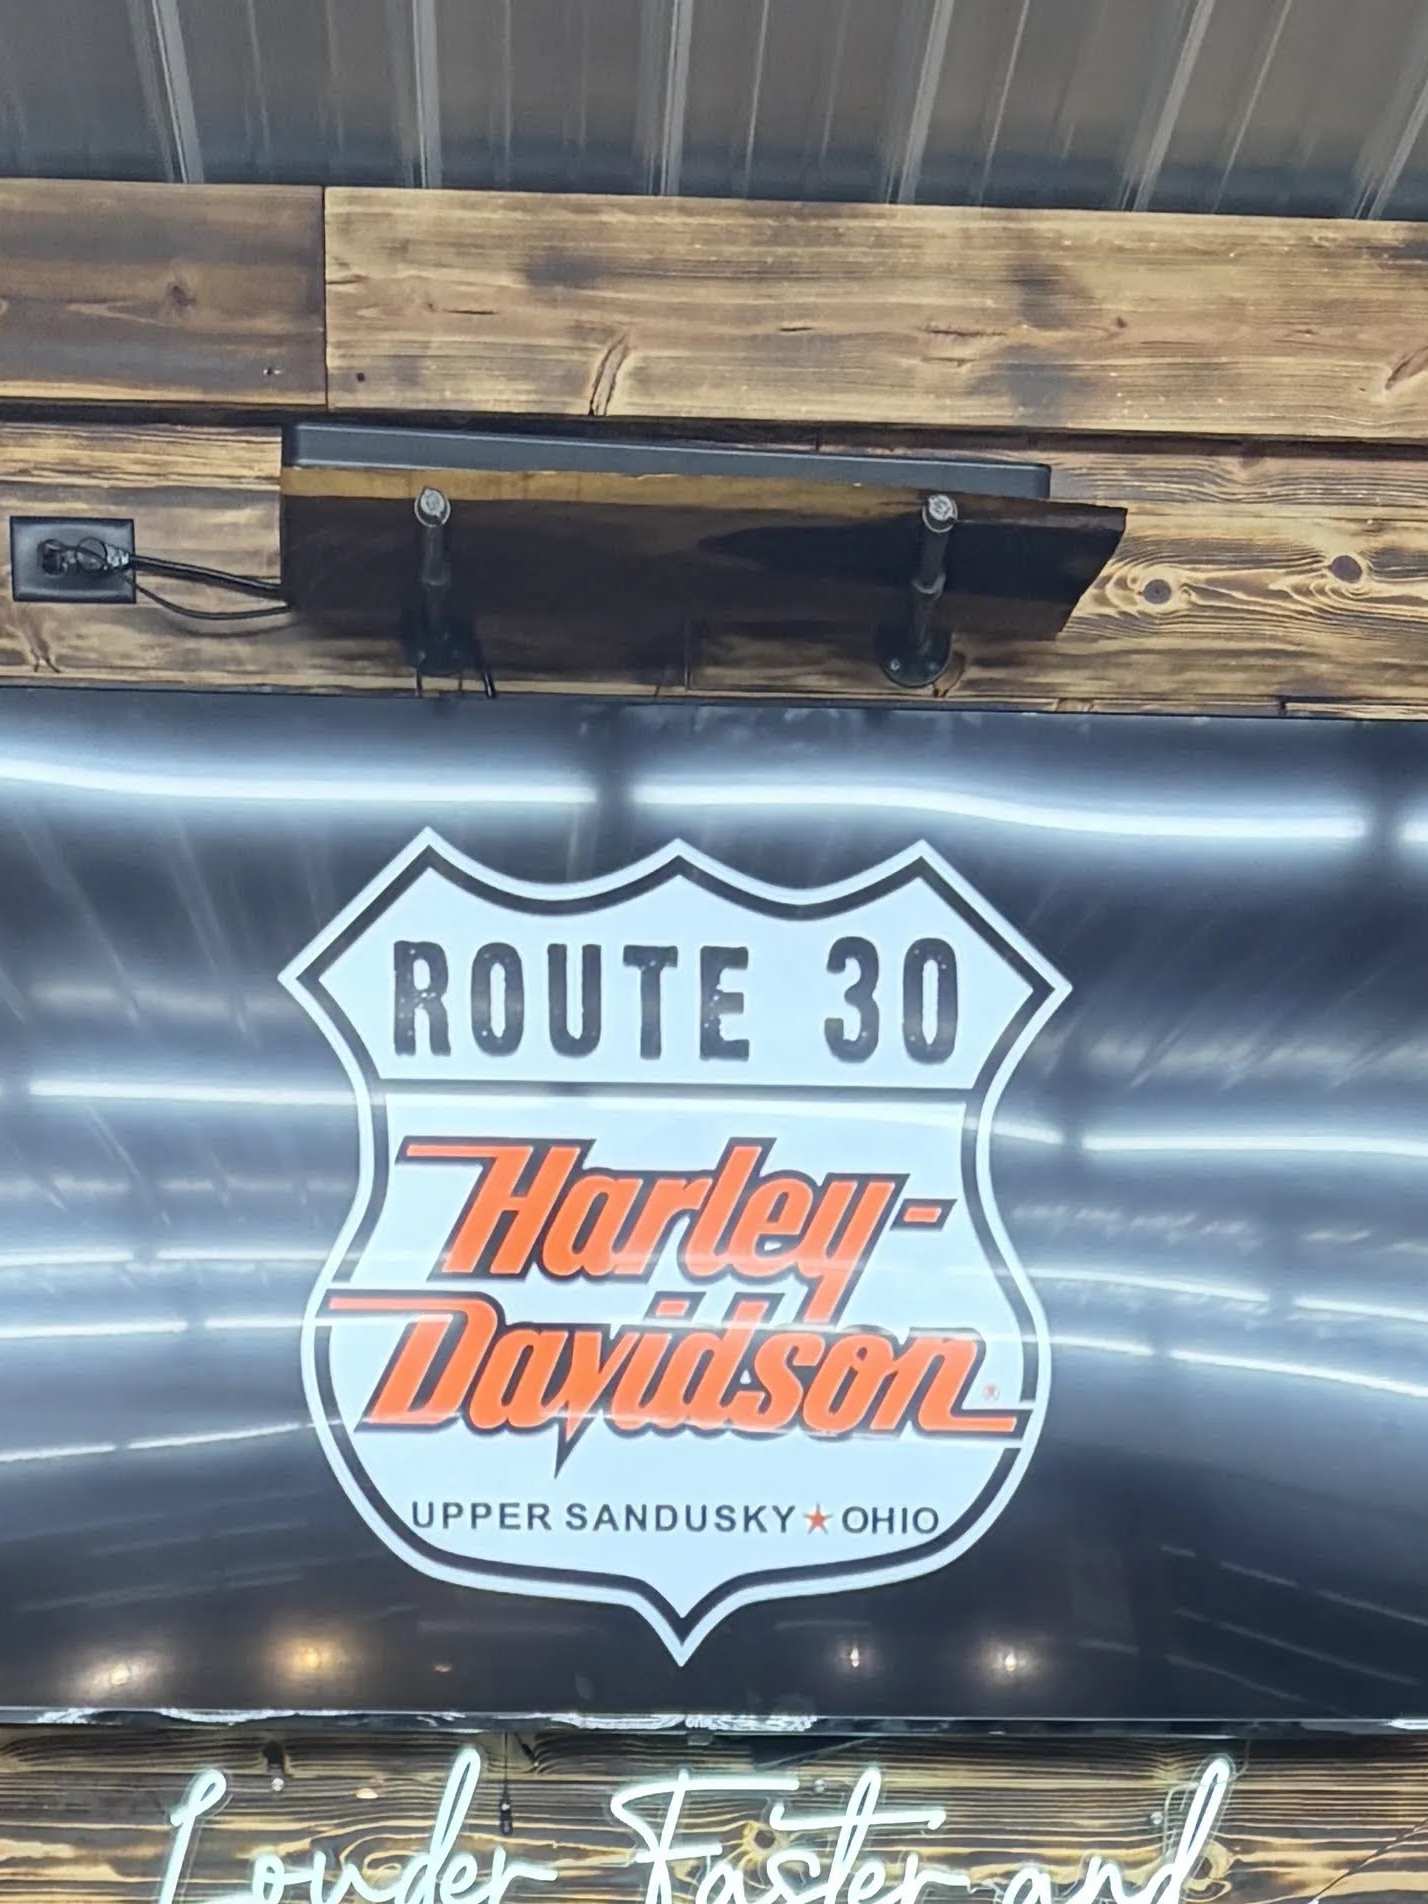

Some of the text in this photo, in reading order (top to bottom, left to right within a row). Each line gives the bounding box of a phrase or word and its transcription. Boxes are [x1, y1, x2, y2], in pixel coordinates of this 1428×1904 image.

[392, 936, 960, 1064] ROUTE 30
[395, 1137, 957, 1326] Harley-
[318, 1289, 1037, 1480] Davidson
[411, 1500, 940, 1535] UPPER SANDUSKY OHIO
